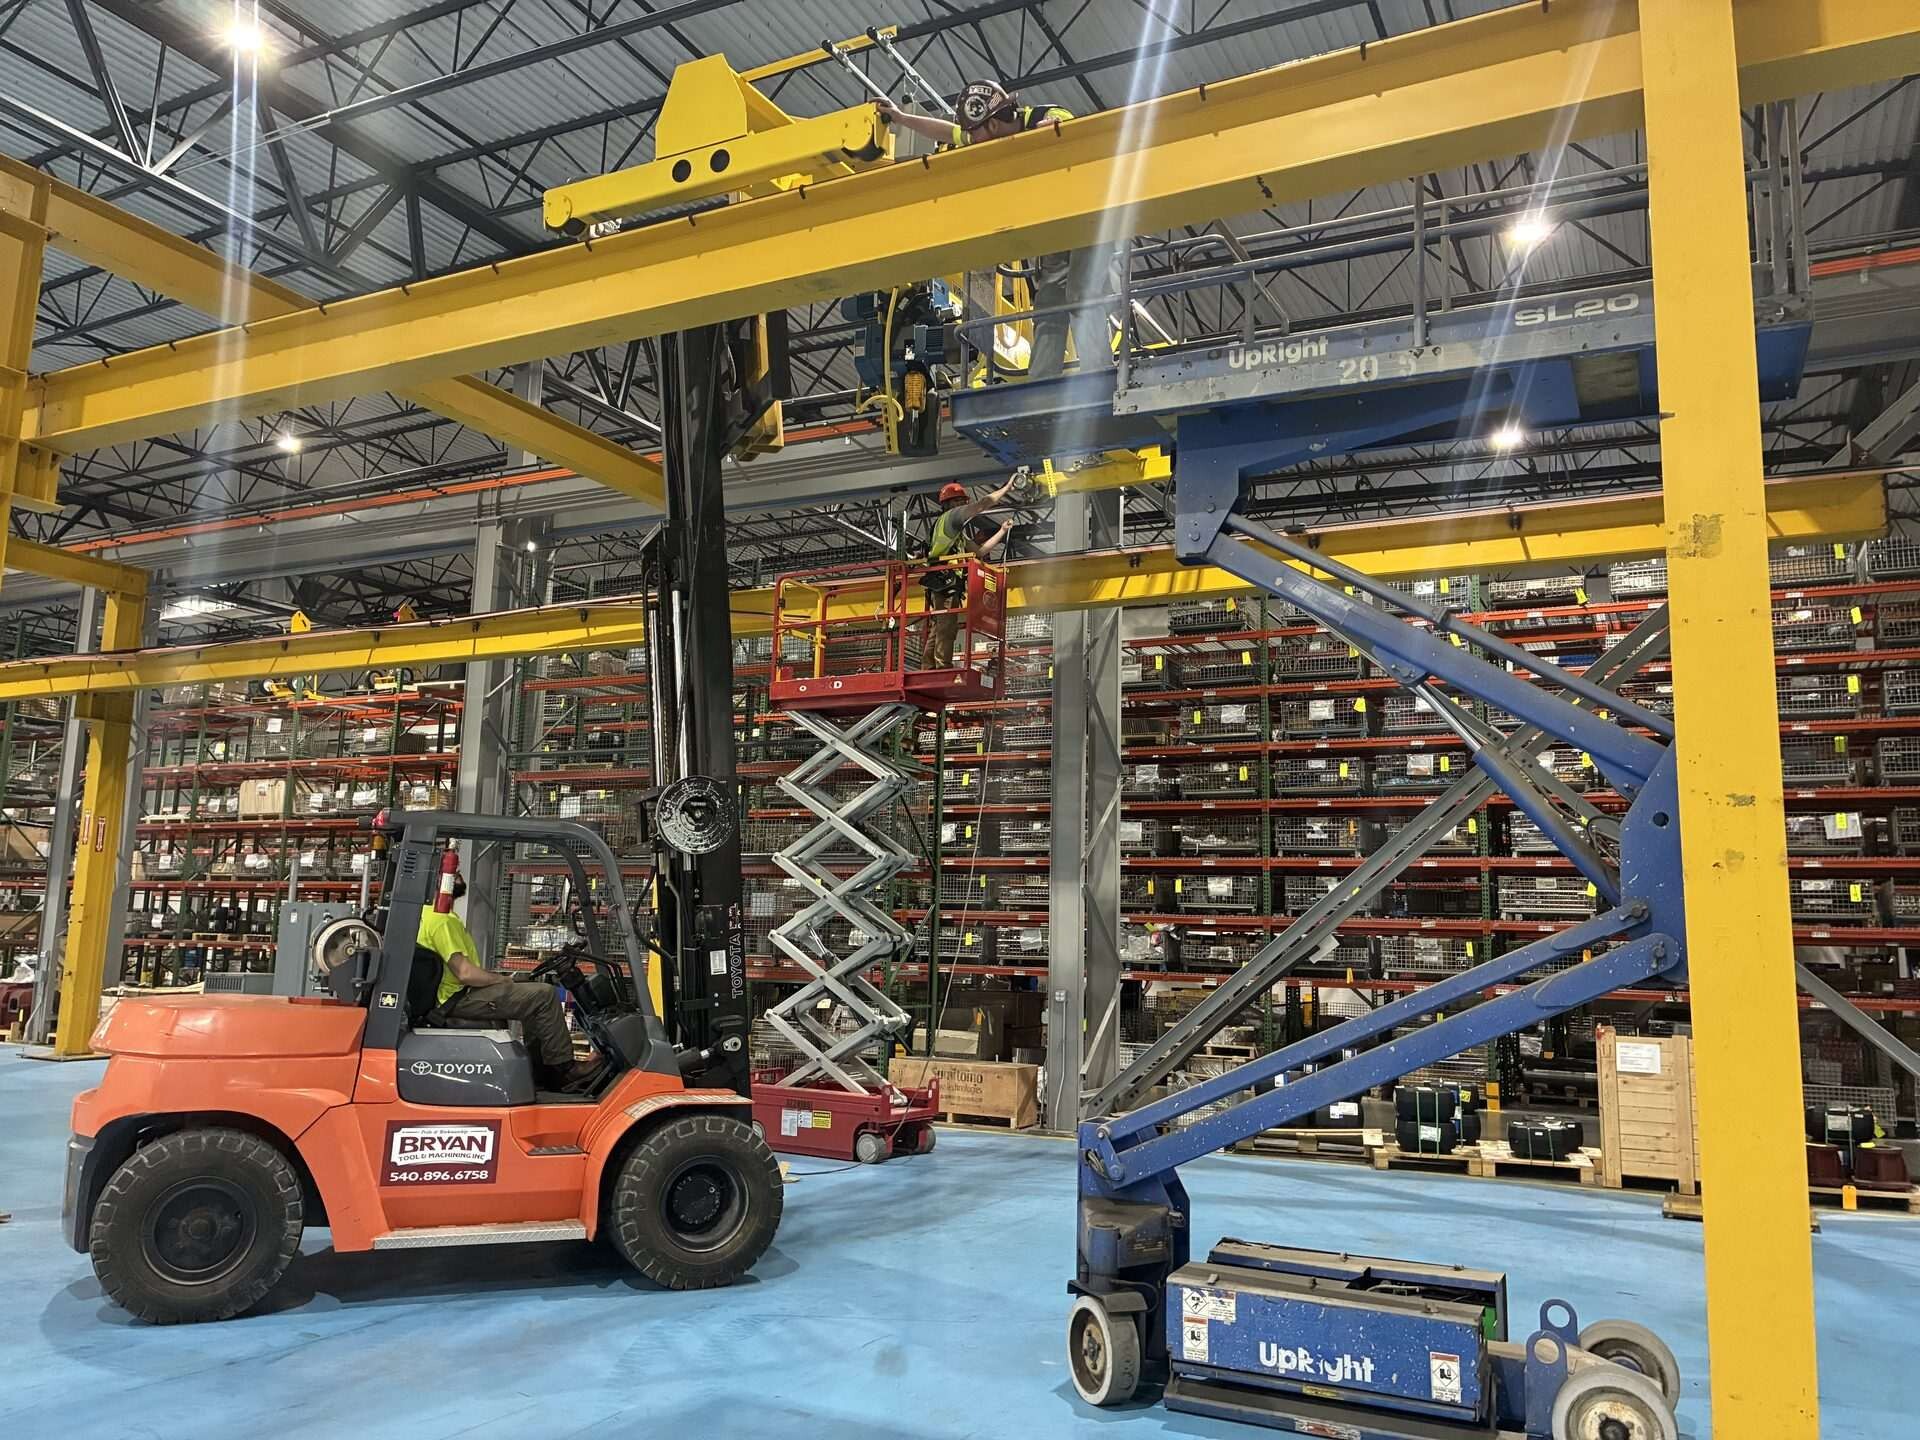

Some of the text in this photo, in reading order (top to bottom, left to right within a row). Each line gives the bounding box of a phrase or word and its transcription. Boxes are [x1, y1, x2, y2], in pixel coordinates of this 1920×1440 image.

[1515, 293, 1639, 327] SL20
[1229, 335, 1328, 370] UpRight
[1339, 356, 1378, 385] 20
[728, 933, 744, 999] TOYOTA
[435, 1063, 493, 1074] TOYOTA
[399, 1135, 487, 1154] BRYAN
[399, 1154, 420, 1162] TOOL
[390, 1170, 488, 1182] 540.896.6758
